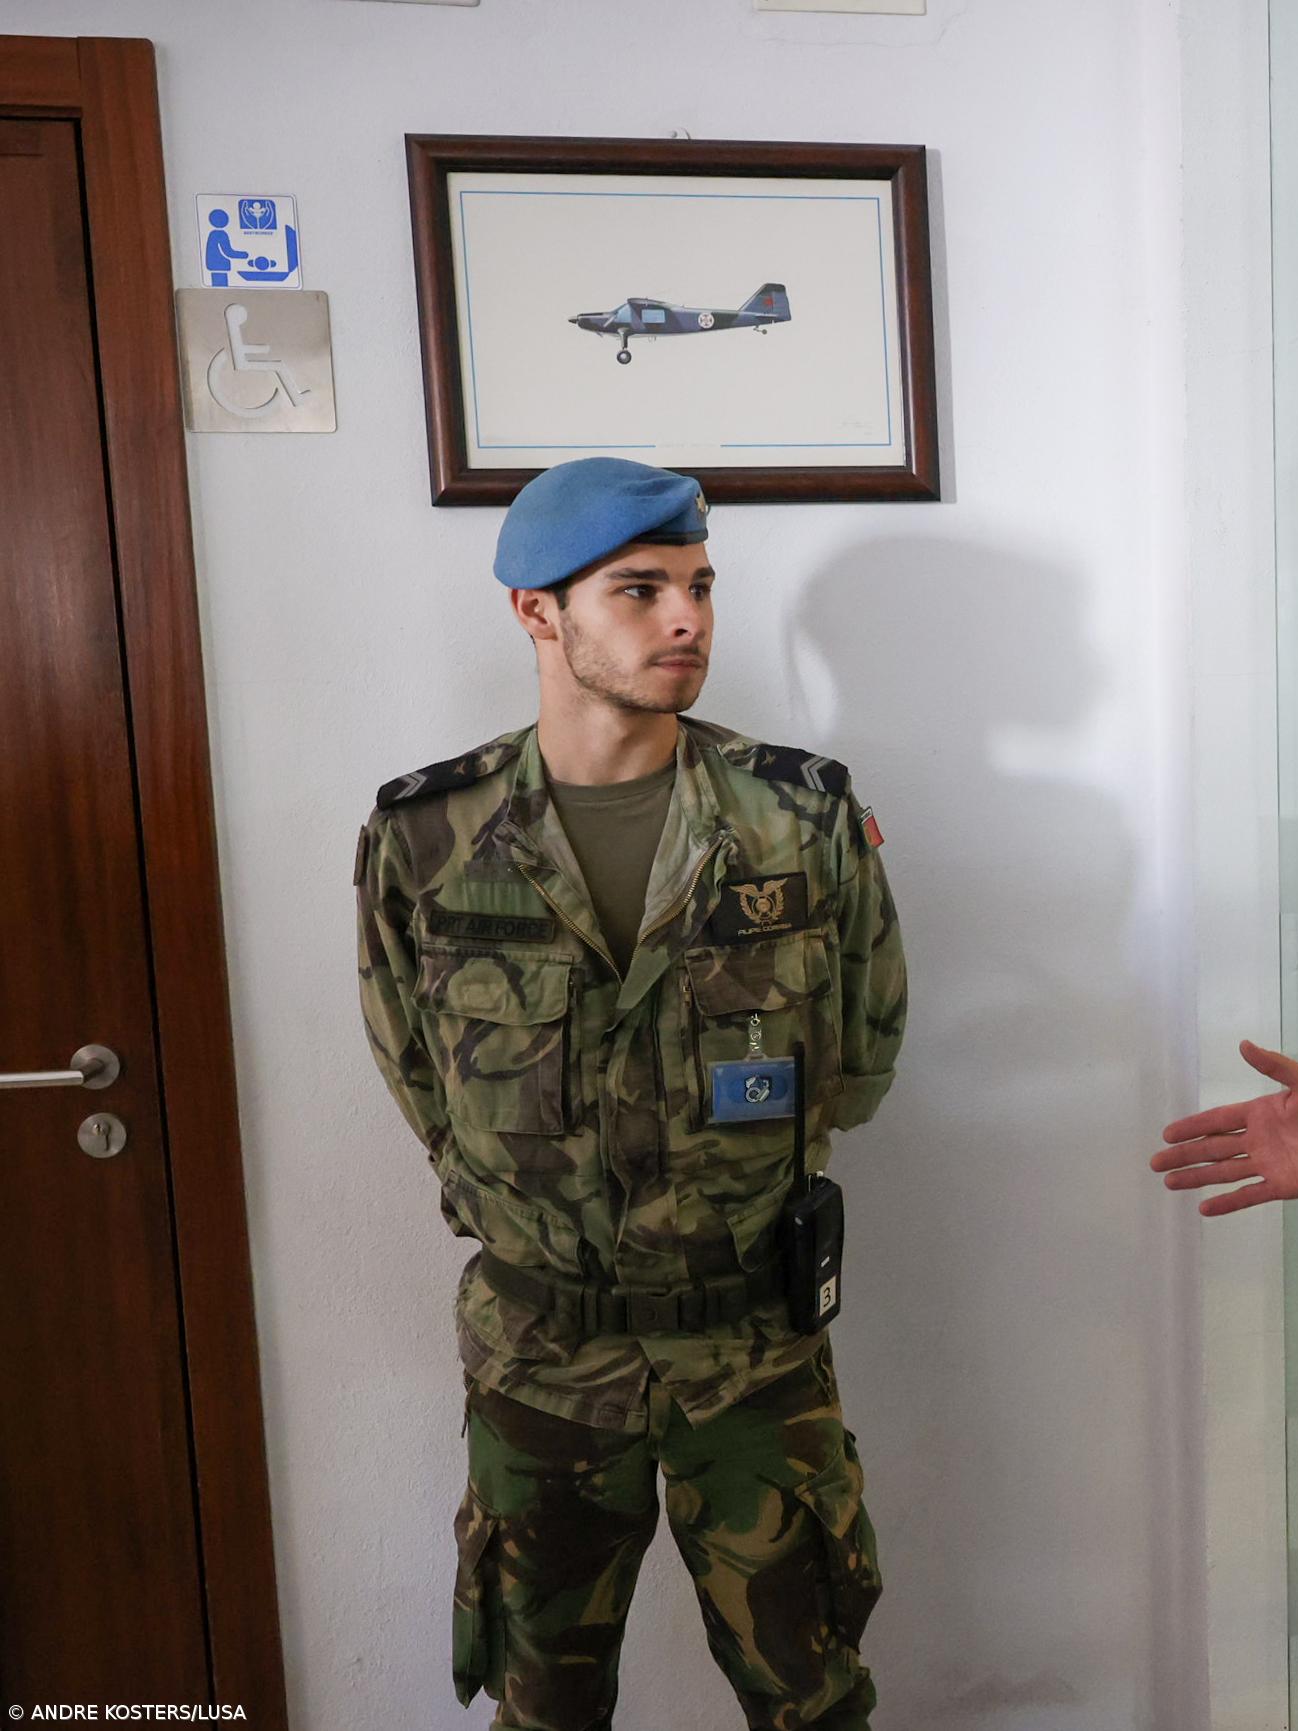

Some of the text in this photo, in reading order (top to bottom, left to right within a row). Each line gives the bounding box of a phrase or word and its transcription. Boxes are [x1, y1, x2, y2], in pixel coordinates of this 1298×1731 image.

[466, 917, 494, 935] AIR
[496, 919, 549, 938] FORCE
[823, 1286, 832, 1308] 3
